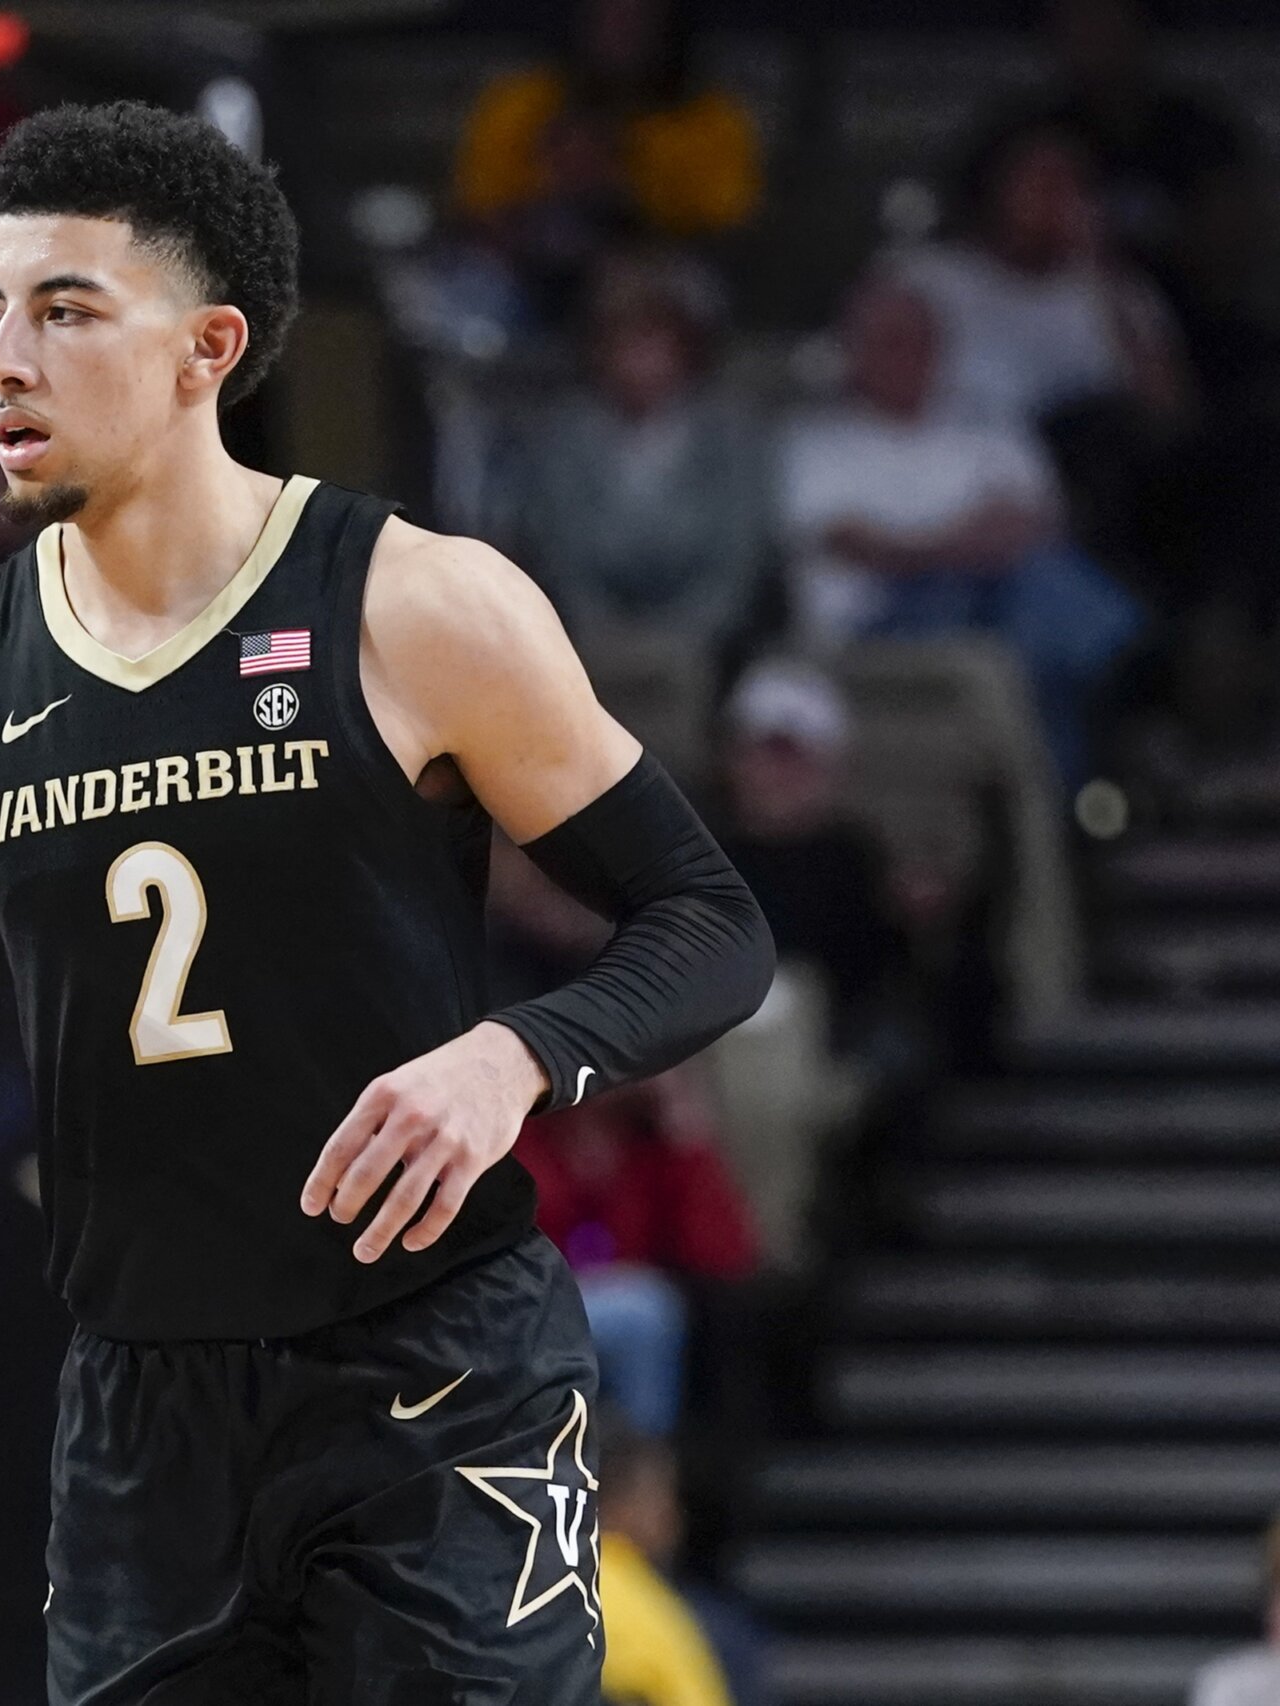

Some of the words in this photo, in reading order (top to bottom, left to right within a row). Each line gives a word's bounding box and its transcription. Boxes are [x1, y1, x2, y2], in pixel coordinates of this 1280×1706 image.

[258, 685, 296, 728] SEC
[105, 841, 233, 1065] 2
[547, 1484, 587, 1566] V
